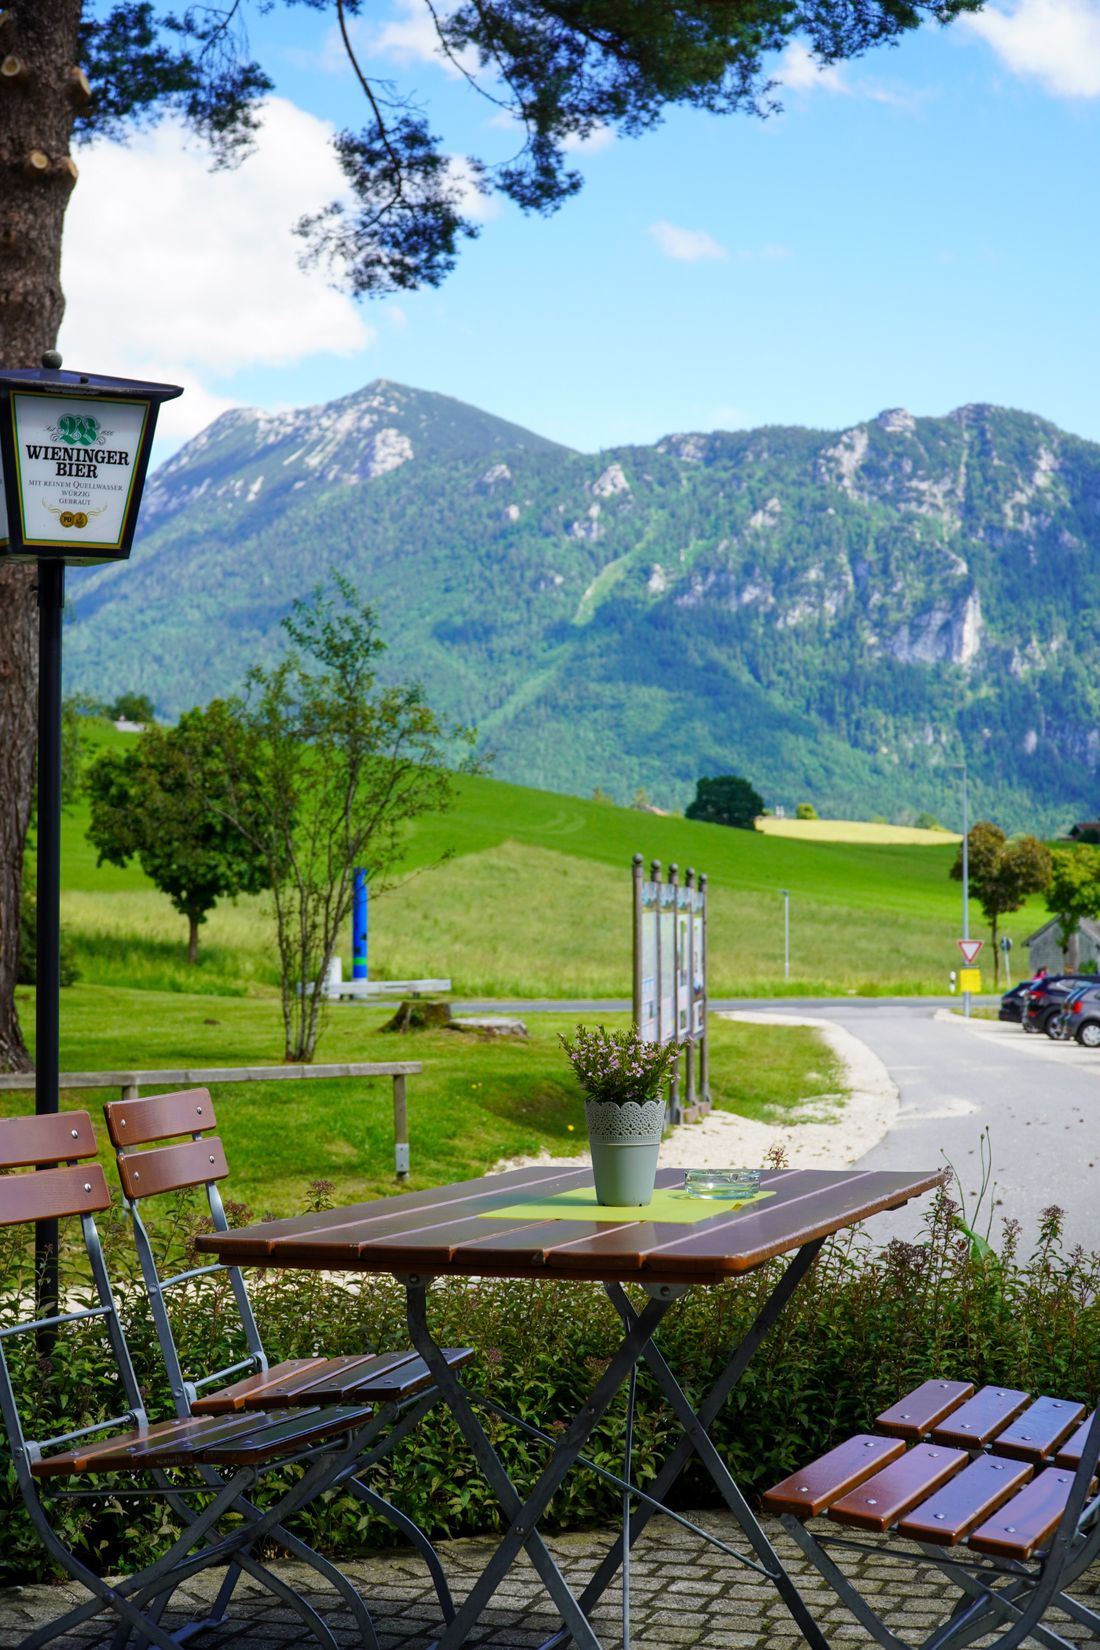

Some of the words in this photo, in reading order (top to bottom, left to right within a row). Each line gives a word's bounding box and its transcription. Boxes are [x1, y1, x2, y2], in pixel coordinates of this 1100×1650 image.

[26, 445, 129, 465] WIENINGER
[56, 462, 98, 478] BIER
[72, 481, 123, 491] QUELLWASSER
[58, 498, 91, 506] GEBRAUT
